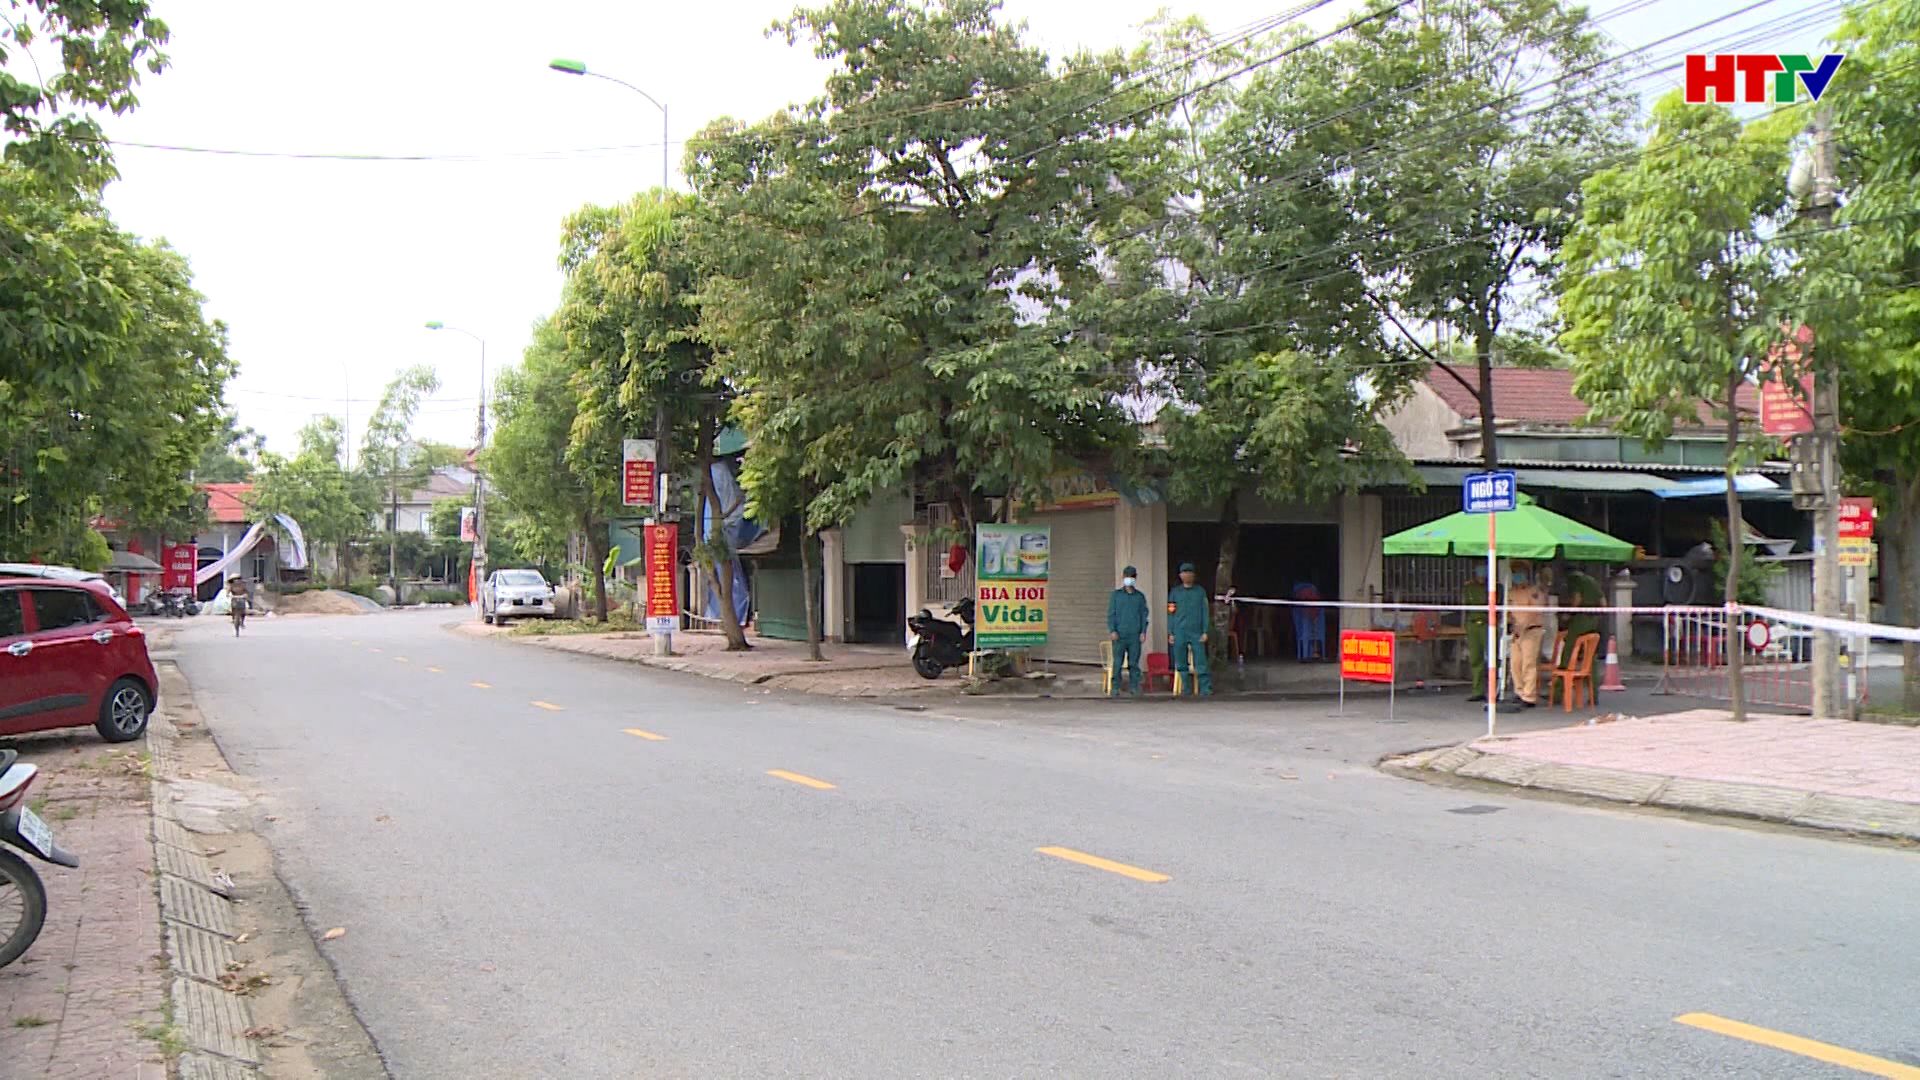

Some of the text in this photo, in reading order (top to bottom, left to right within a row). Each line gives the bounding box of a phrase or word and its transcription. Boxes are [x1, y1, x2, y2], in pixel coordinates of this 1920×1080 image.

[1495, 479, 1509, 496] 52
[980, 587, 1009, 600] BIA
[982, 605, 1043, 623] Vida
